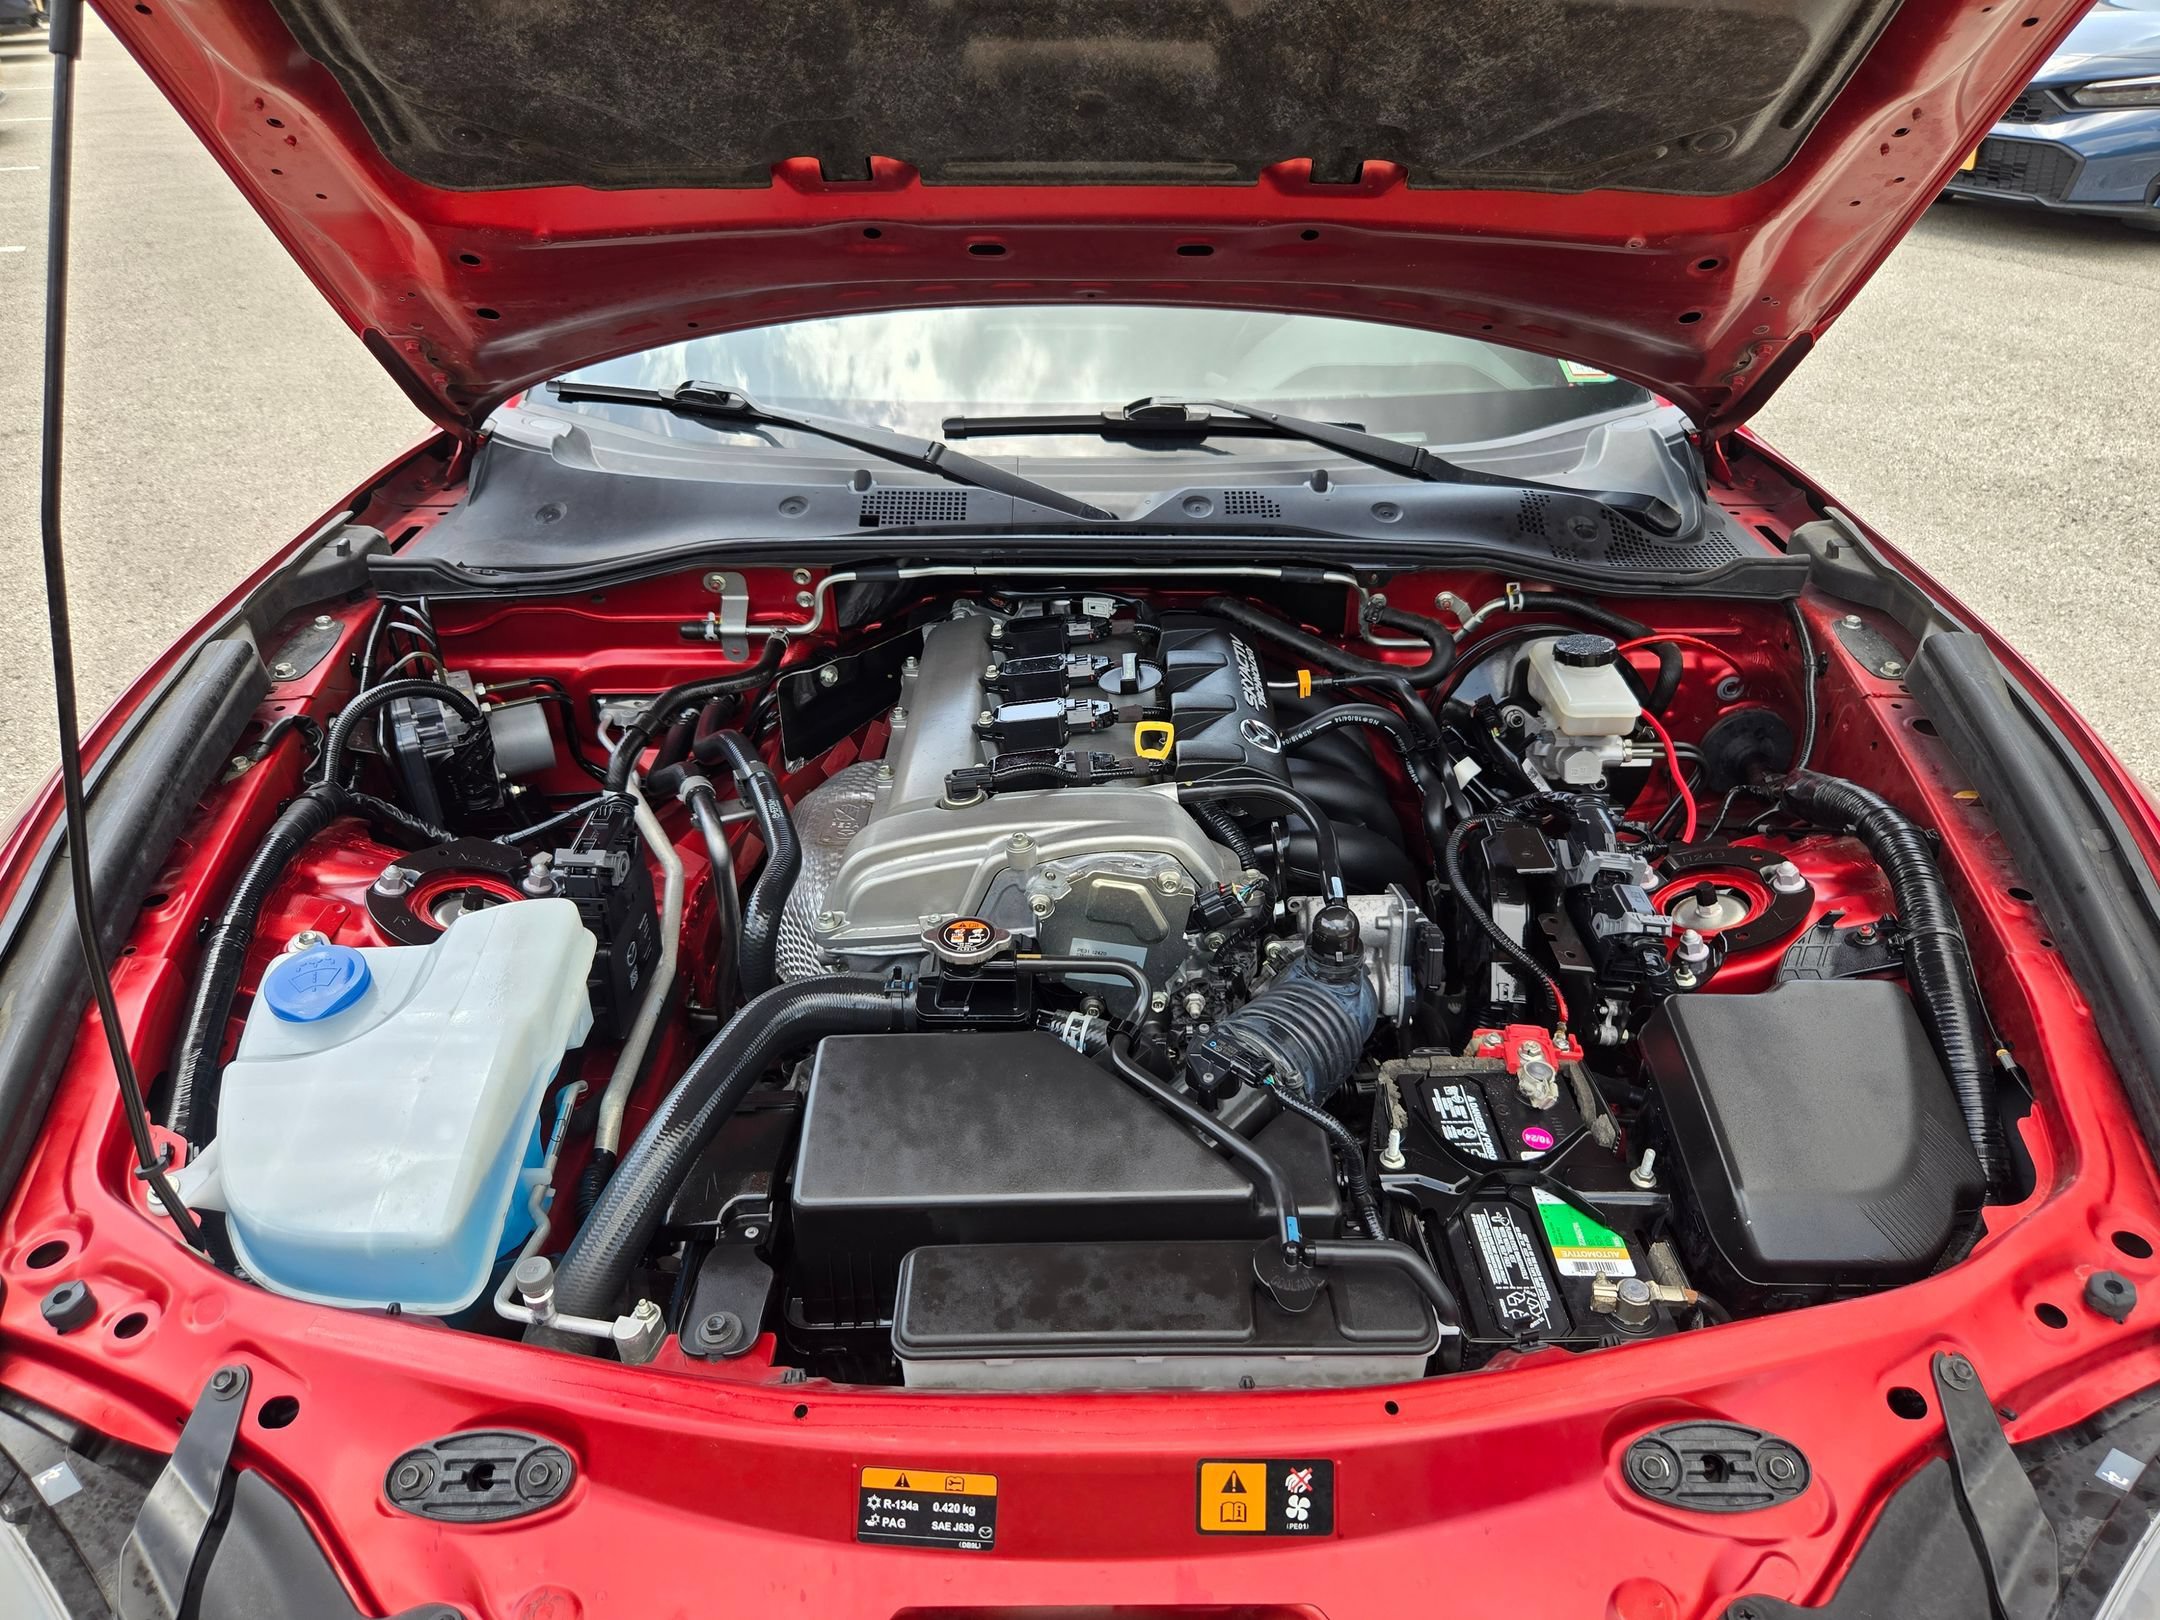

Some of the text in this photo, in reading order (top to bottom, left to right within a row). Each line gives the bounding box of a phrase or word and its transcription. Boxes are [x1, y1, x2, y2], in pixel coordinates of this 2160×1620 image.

[1229, 632, 1259, 712] SKYACTIV
[1244, 643, 1268, 709] TECHNOLOGY
[1525, 1133, 1551, 1145] 10/24
[1561, 1250, 1620, 1258] AUTOMOTIVE
[1271, 1275, 1315, 1291] COOLANT
[883, 1499, 976, 1516] R-134a 0.420 kg
[882, 1517, 975, 1532] PAG SAE J639
